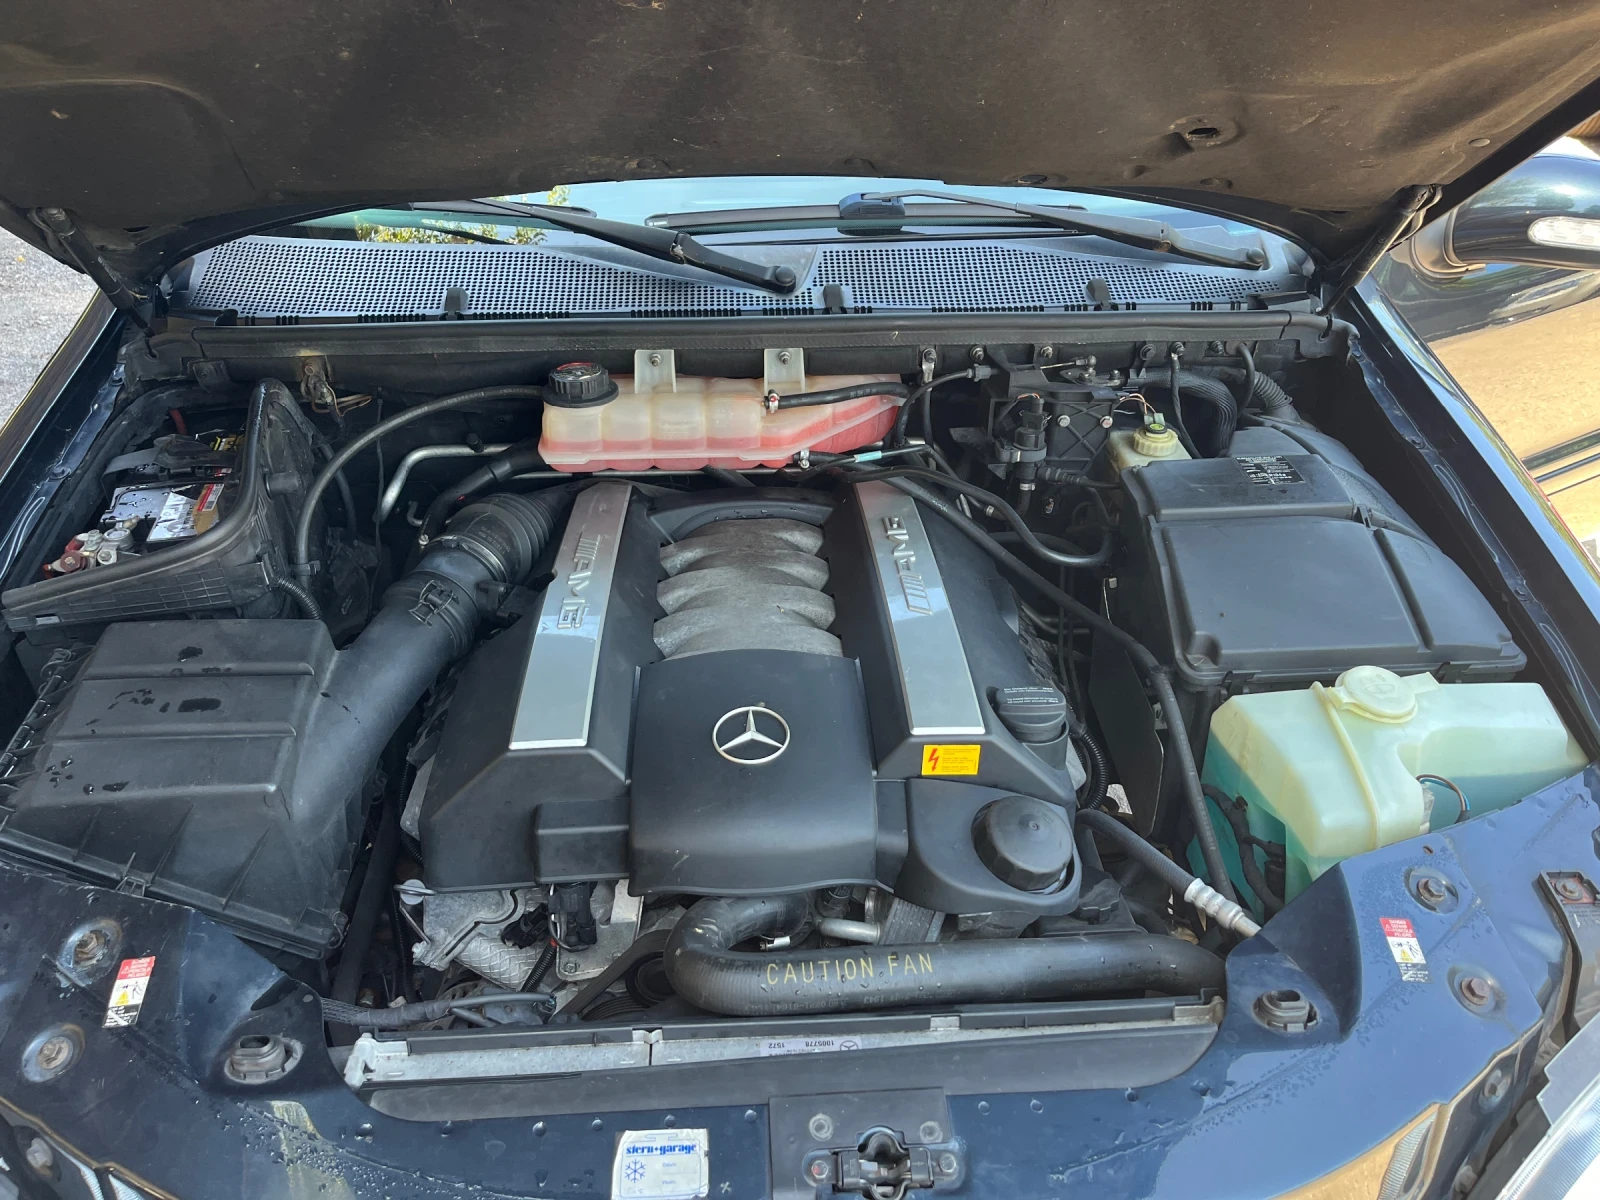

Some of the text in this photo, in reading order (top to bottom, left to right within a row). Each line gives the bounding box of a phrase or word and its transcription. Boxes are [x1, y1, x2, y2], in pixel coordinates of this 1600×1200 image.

[881, 516, 917, 575] AMG
[557, 558, 595, 629] AMG
[766, 952, 933, 985] CAUTION FAN
